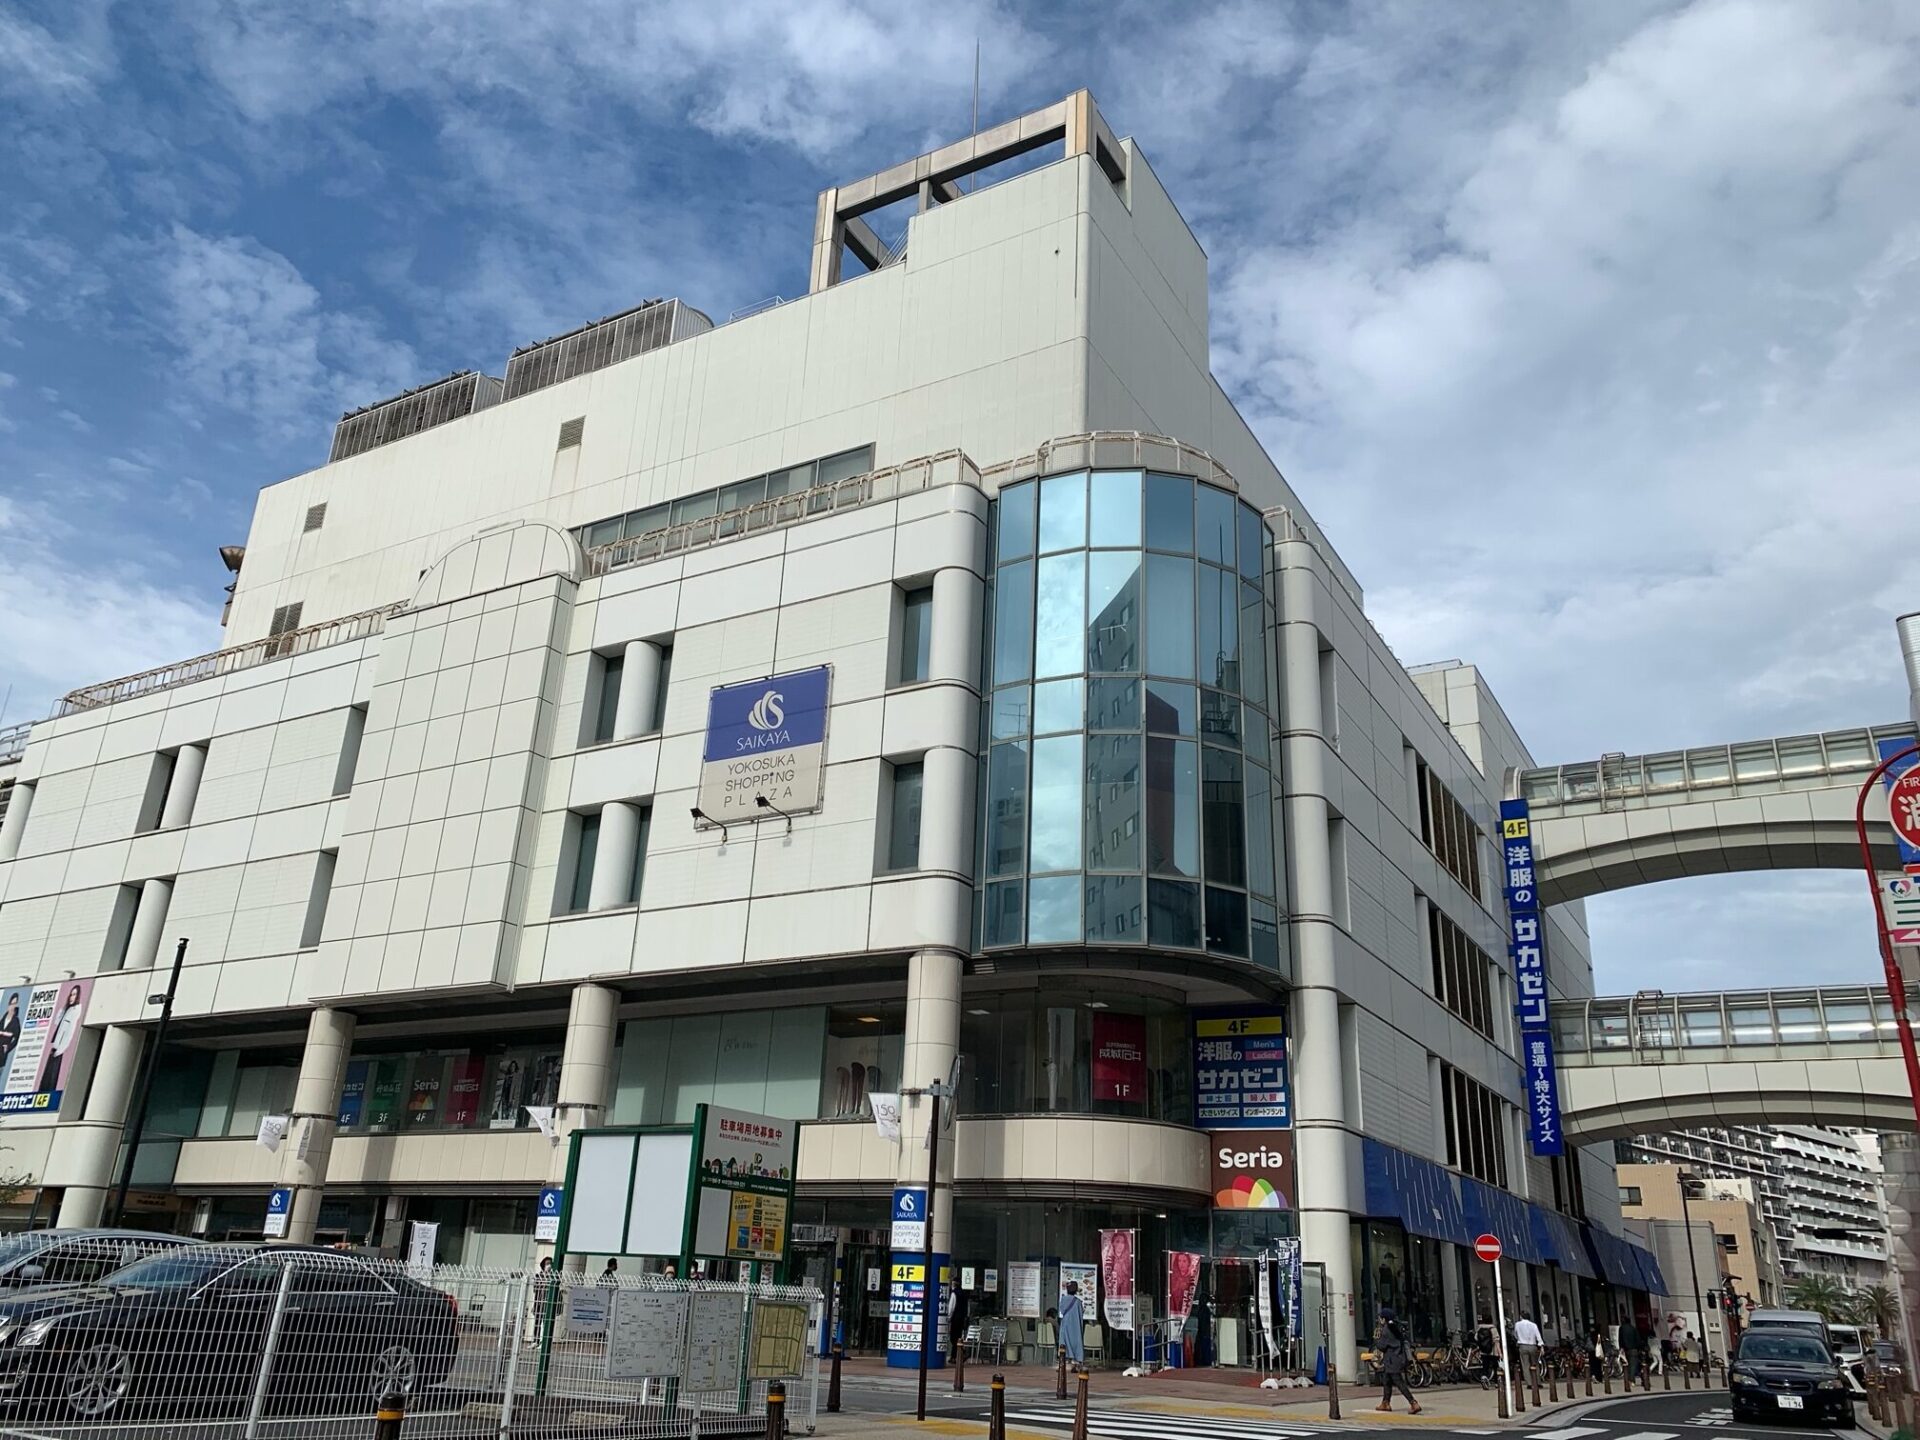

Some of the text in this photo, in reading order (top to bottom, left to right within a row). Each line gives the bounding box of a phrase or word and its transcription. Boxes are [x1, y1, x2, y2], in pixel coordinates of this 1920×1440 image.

[736, 730, 791, 752] SAIKAYA
[727, 753, 796, 776] YOKOSUKA
[1505, 821, 1527, 837] 4F
[1507, 845, 1533, 903] 洋服の
[1514, 918, 1547, 1023] サカゼン
[31, 989, 58, 1004] IMPORT
[26, 1006, 53, 1021] BRAND
[1228, 1019, 1250, 1034] 4F
[1198, 1041, 1242, 1061] 洋服の
[1253, 1040, 1276, 1048] Men's
[413, 1078, 440, 1091] Seria
[1197, 1067, 1283, 1090] サカゼン
[1114, 1083, 1131, 1097] 1F
[37, 1095, 48, 1106] 4F
[340, 1113, 351, 1124] 4F
[378, 1112, 388, 1123] 3F
[415, 1112, 426, 1122] 4F
[456, 1110, 467, 1121] 1F
[1200, 1108, 1239, 1117] 大きいサイズ
[1219, 1145, 1283, 1169] Seria
[897, 1266, 915, 1280] 4F
